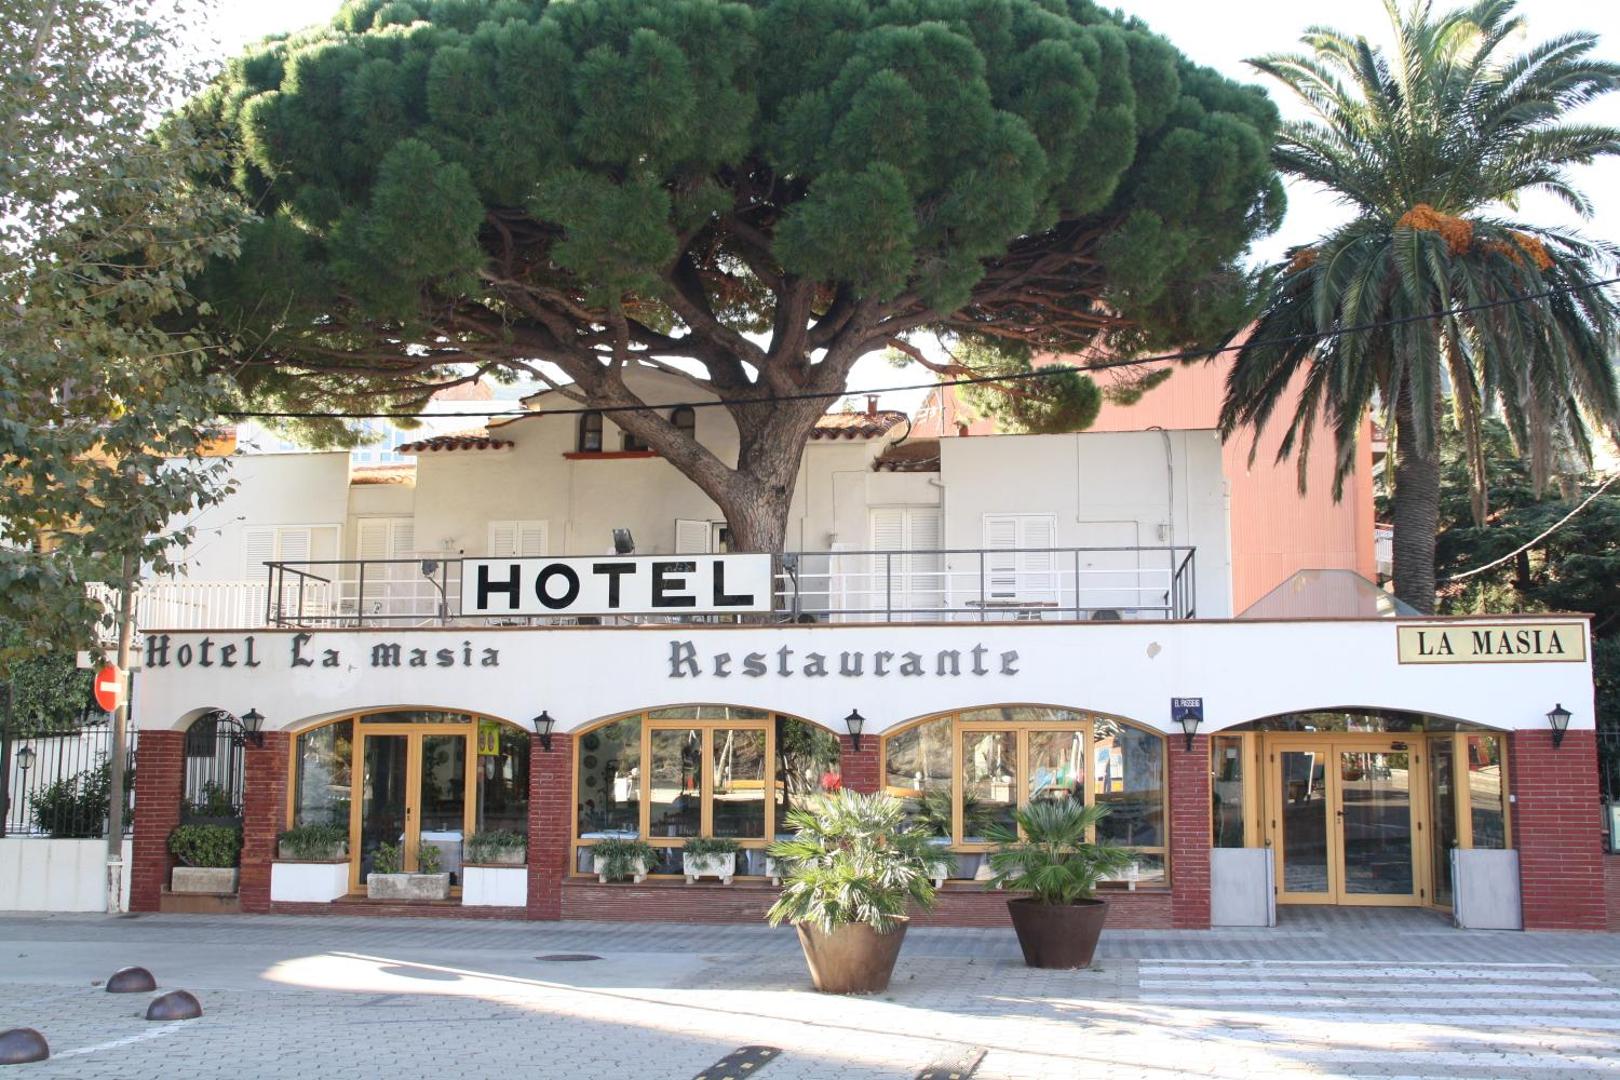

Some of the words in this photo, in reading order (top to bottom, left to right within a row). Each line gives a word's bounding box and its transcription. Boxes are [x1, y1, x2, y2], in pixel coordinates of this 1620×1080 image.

[476, 560, 755, 610] HOTEL
[145, 633, 262, 669] Hotel
[290, 631, 341, 669] La
[667, 640, 1021, 679] Restaurante
[1416, 630, 1455, 656] LA
[1472, 629, 1566, 655] MASIA
